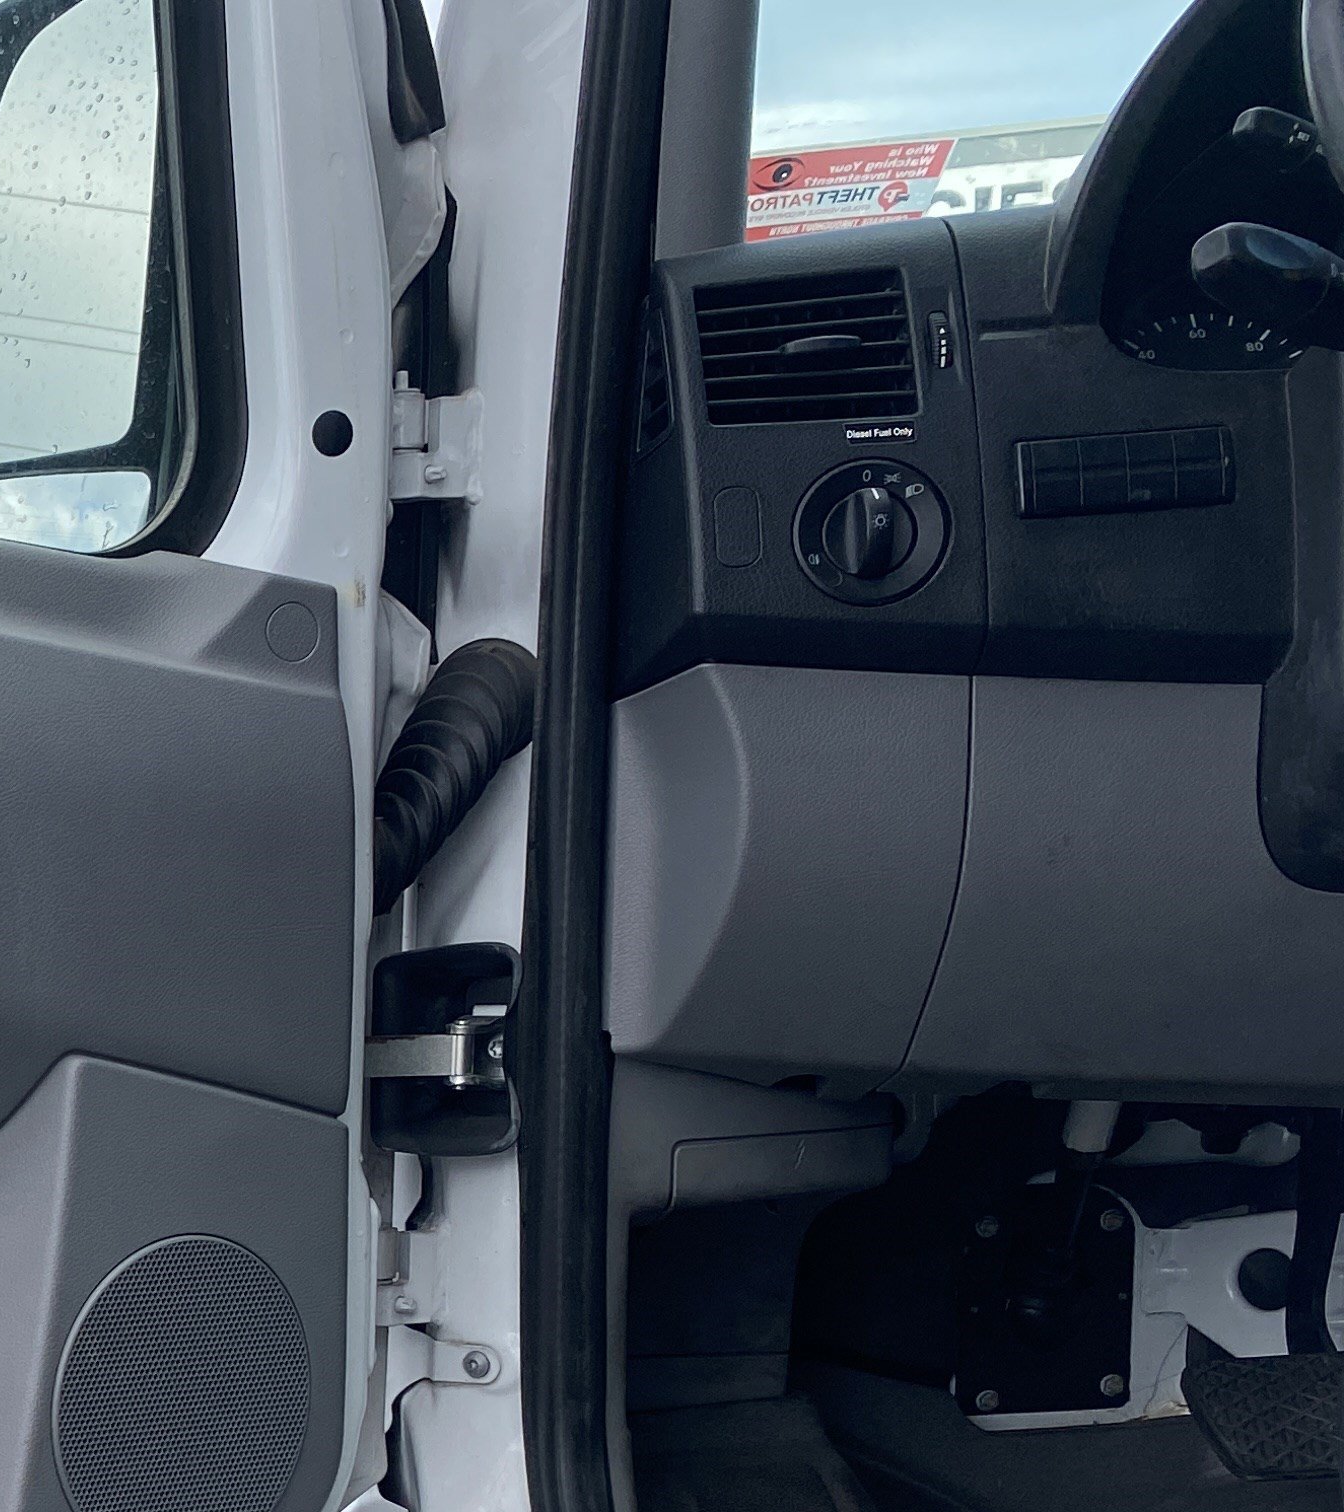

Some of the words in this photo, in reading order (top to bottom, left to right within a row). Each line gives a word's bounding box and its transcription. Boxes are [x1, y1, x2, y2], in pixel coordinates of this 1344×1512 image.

[1189, 328, 1206, 338] 60
[1246, 342, 1263, 351] 80
[1138, 349, 1155, 359] 40
[846, 429, 872, 439] Diesel
[873, 428, 892, 437] Fuel
[893, 427, 913, 437] Only
